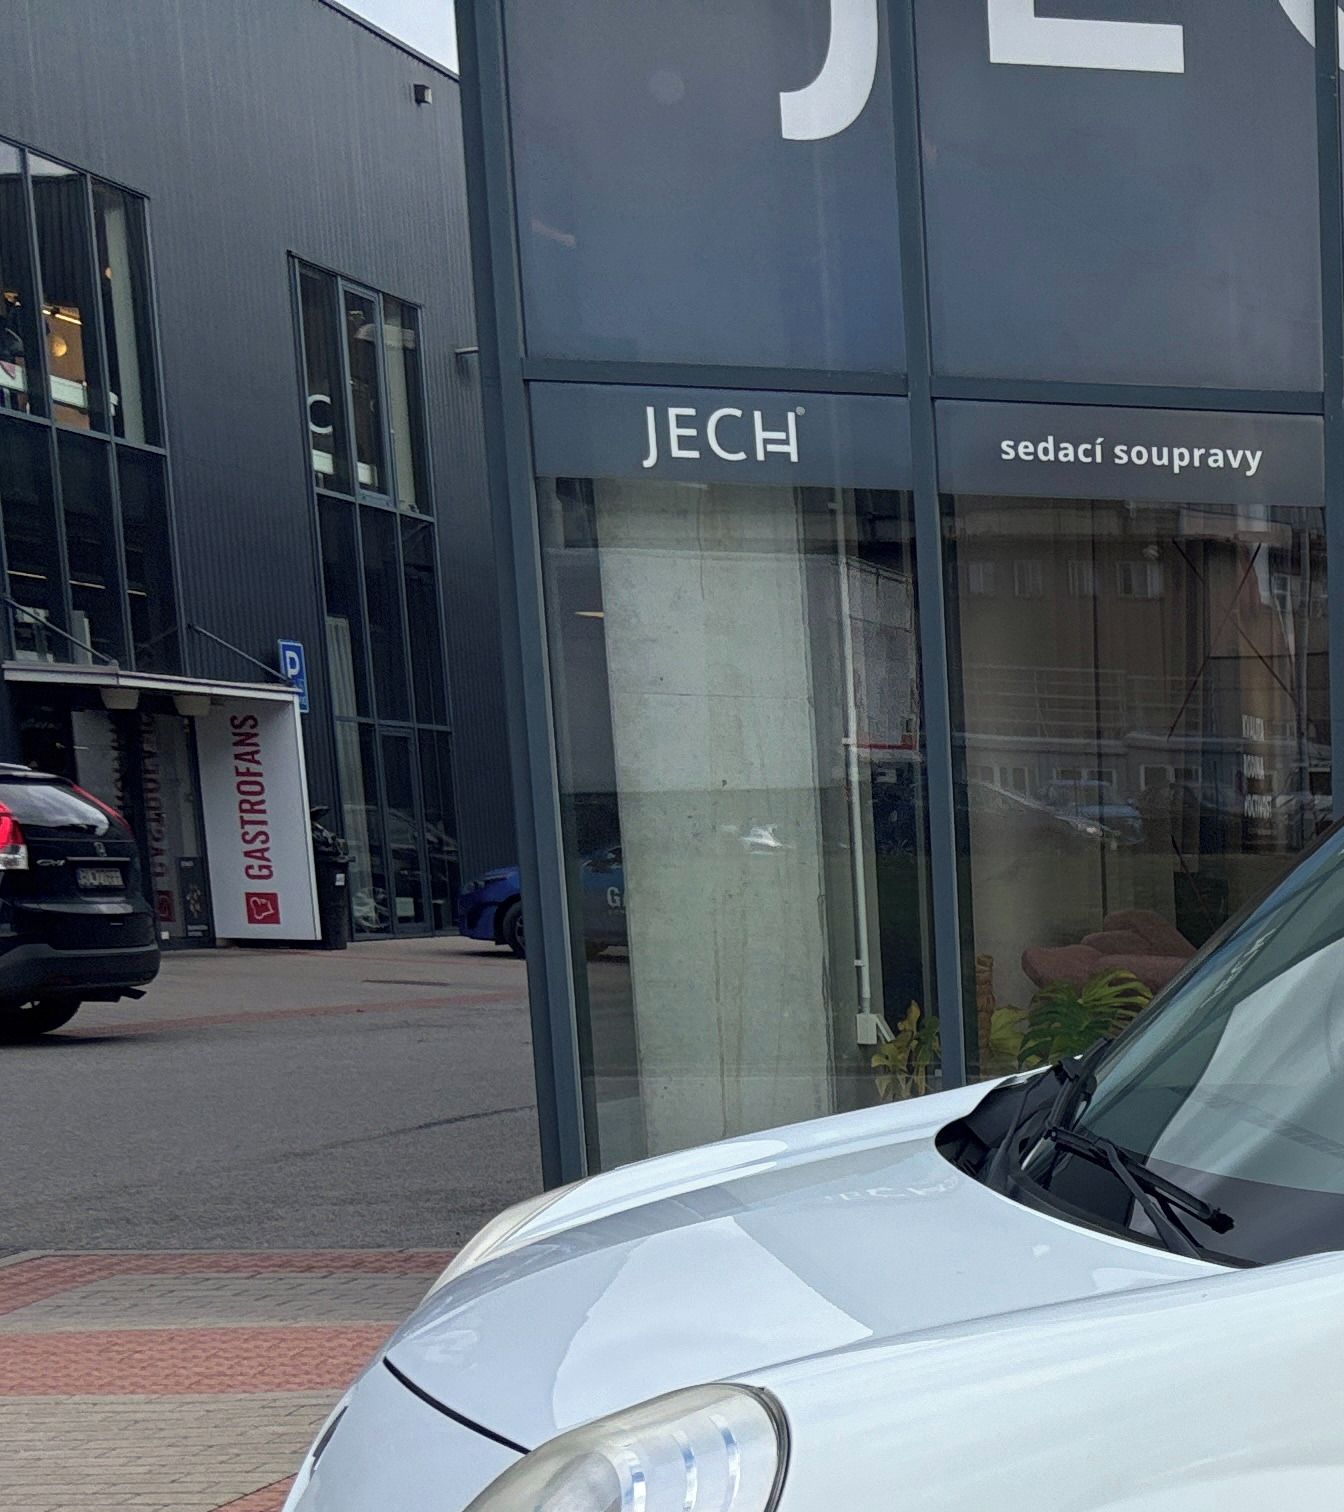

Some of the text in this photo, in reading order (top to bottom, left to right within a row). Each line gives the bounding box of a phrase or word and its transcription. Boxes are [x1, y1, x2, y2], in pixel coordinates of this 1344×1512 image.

[642, 406, 799, 468] JECH
[1000, 435, 1263, 476] sedací soupravy
[230, 714, 274, 880] GASTROFANS
